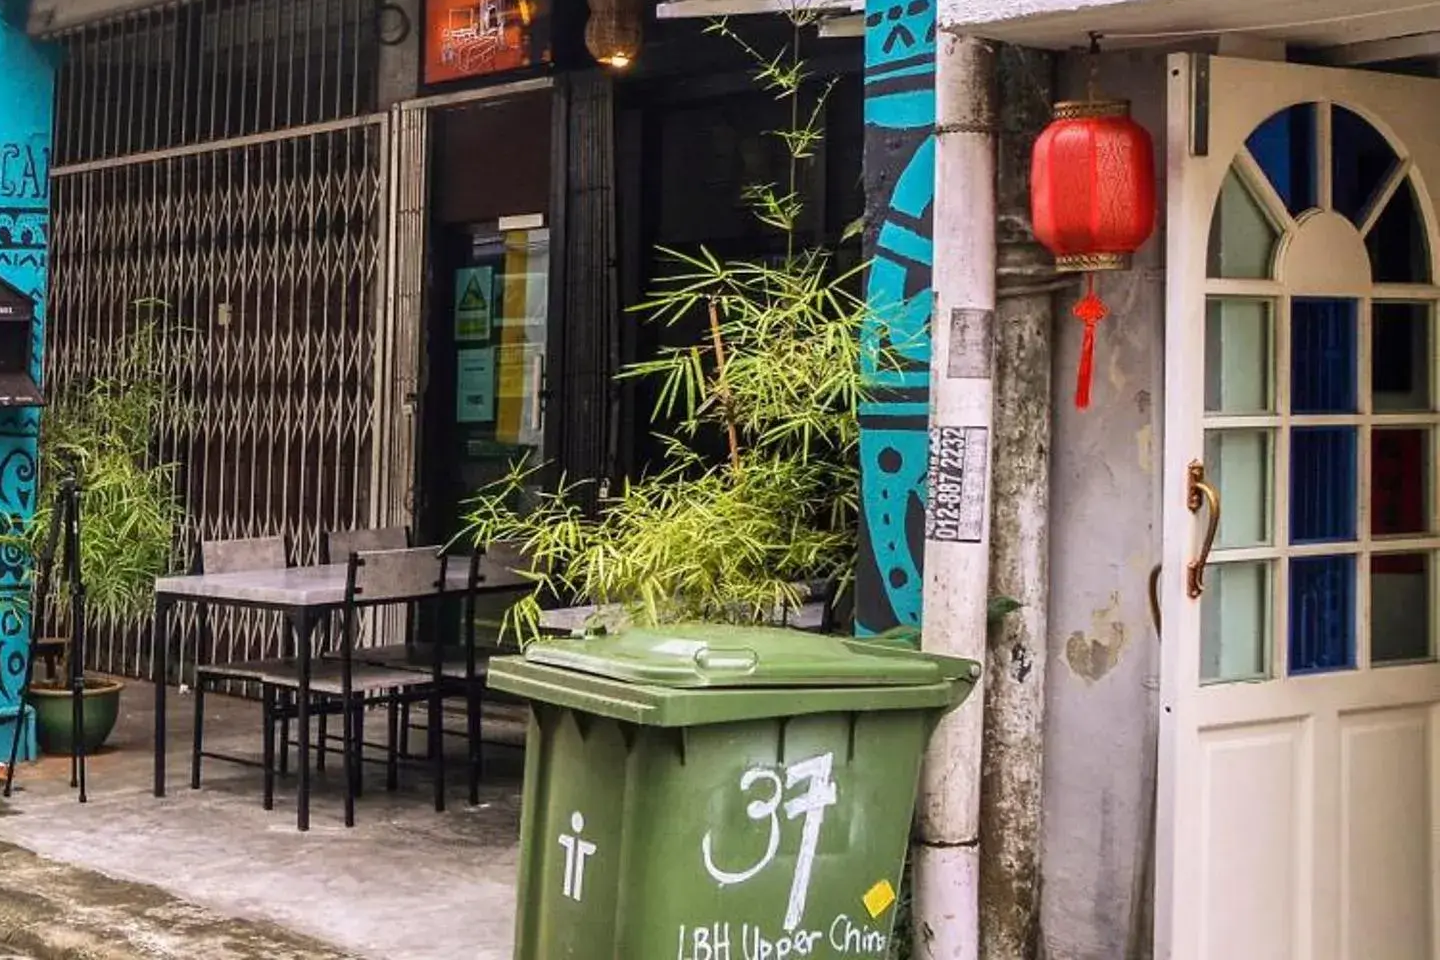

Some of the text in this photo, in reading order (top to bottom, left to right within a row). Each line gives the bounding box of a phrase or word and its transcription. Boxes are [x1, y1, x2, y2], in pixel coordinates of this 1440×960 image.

[939, 428, 966, 469] 2232
[702, 752, 836, 930] 37
[743, 923, 822, 960] Upper
